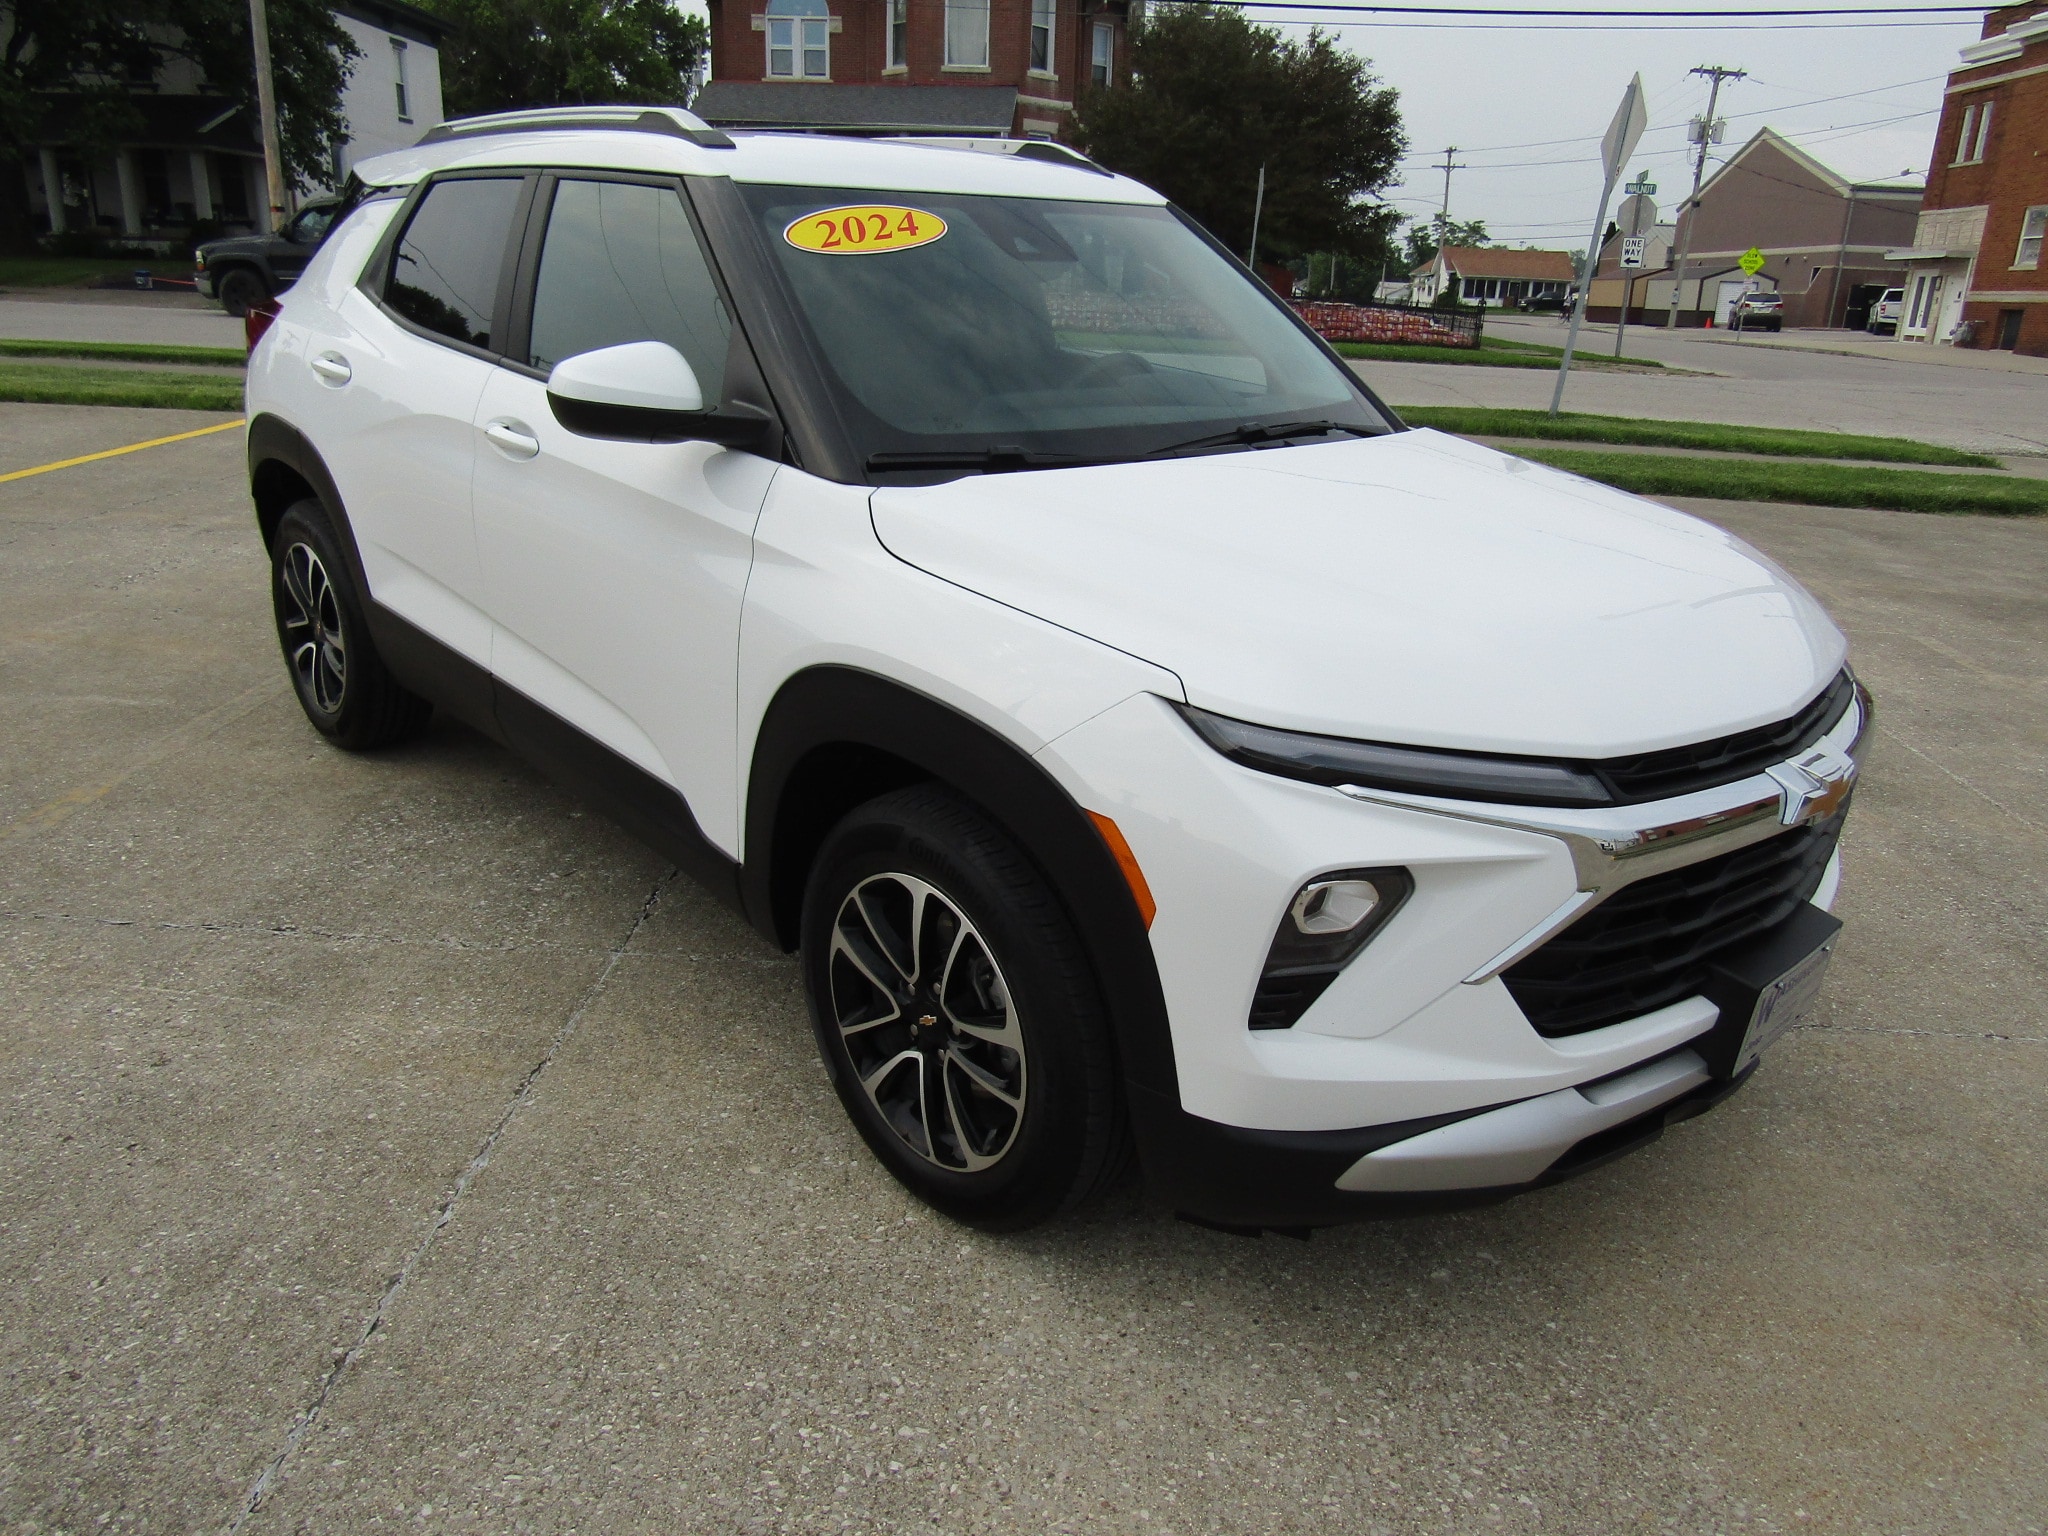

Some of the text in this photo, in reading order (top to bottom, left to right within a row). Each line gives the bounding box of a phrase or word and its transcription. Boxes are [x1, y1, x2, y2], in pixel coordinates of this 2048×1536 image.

[1627, 184, 1654, 194] WALNUT
[815, 211, 919, 248] 2024
[1625, 239, 1643, 248] ONE
[1624, 248, 1642, 257] WAY
